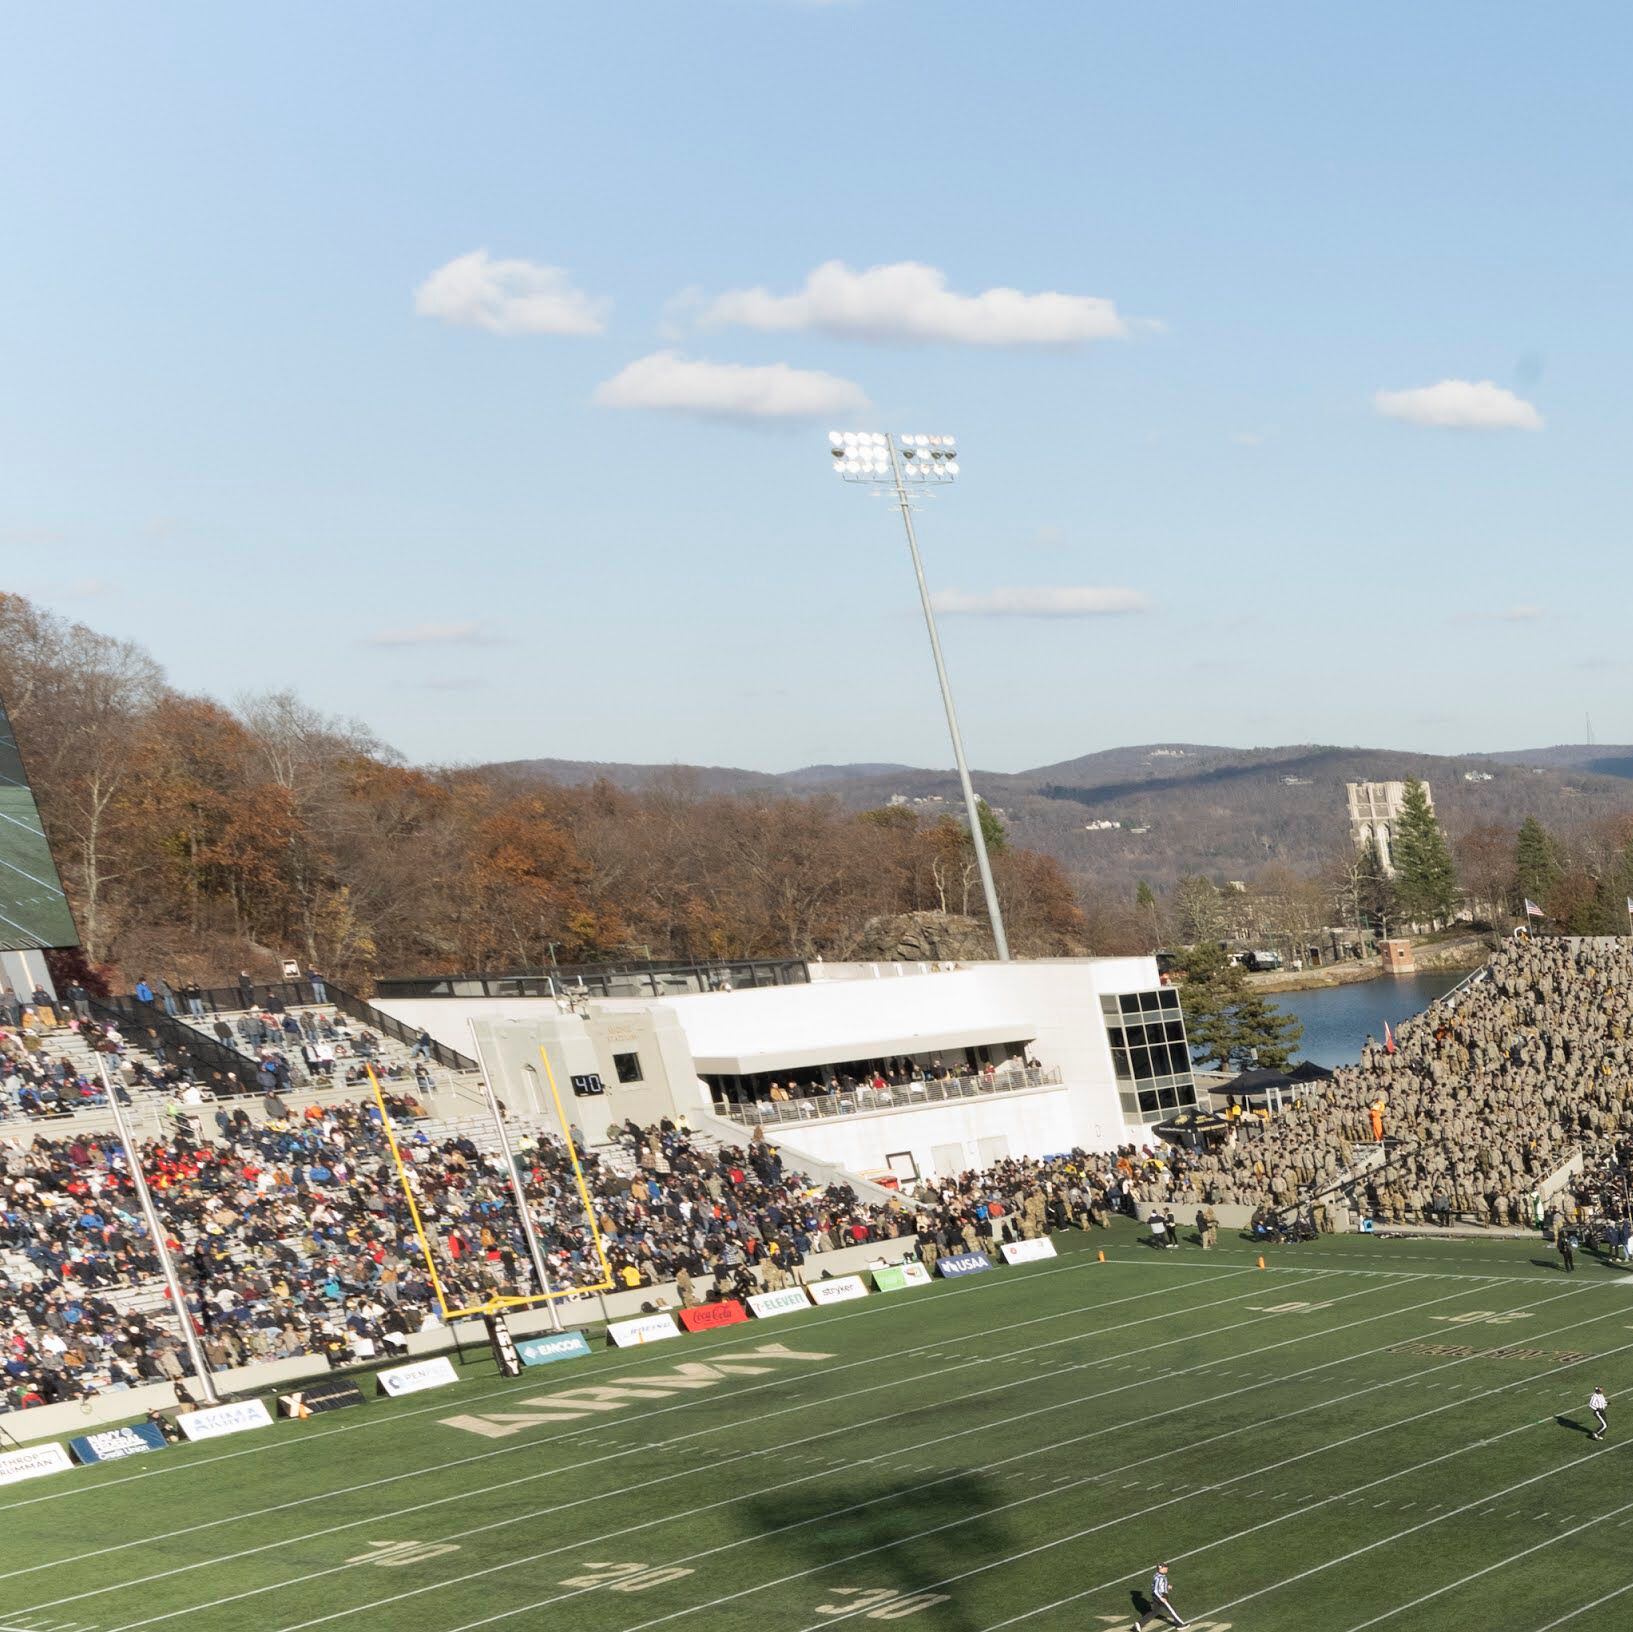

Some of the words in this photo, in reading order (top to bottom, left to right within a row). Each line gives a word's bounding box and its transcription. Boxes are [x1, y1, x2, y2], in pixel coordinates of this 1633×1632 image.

[576, 1075, 602, 1093] 40
[956, 1257, 988, 1272] USAA
[822, 1283, 854, 1297] stryker
[537, 1338, 583, 1356] EMCOR
[437, 1343, 838, 1439] ARMY
[345, 1541, 462, 1567] 10
[557, 1563, 695, 1592] 20
[814, 1587, 951, 1621] 30
